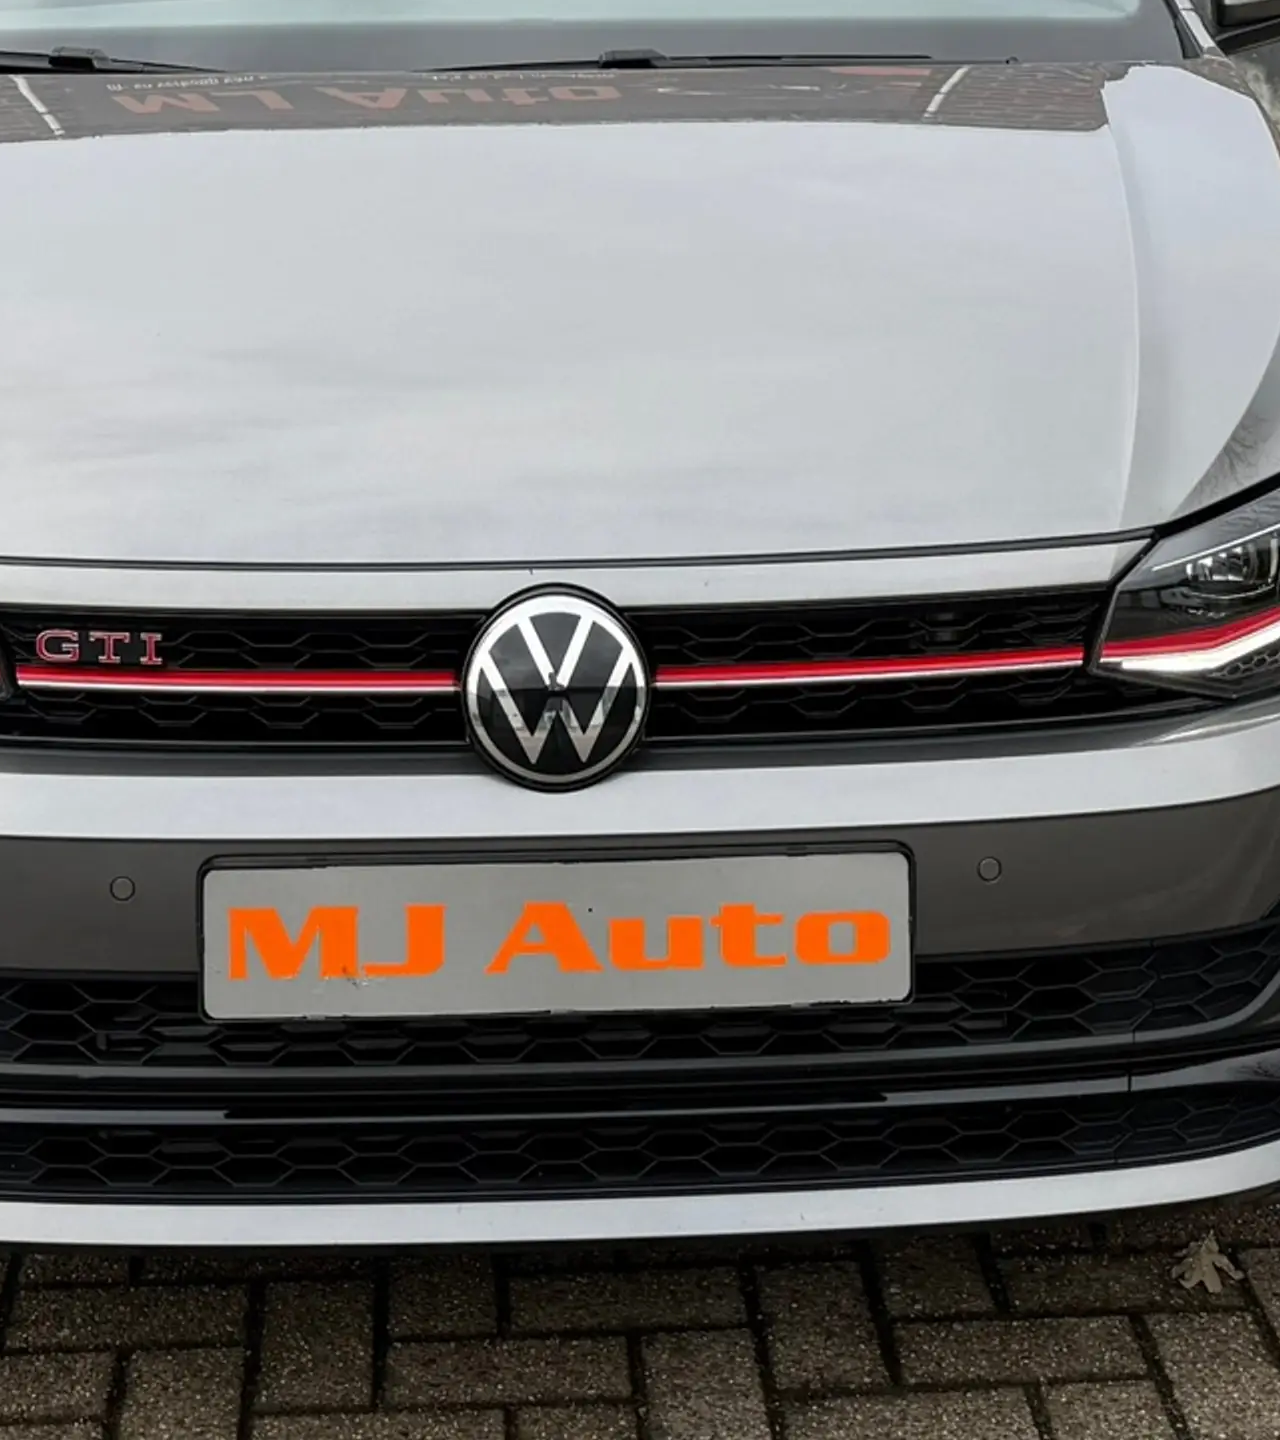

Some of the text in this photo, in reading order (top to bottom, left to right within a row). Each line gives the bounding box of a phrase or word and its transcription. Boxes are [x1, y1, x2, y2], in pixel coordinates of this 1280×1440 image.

[35, 629, 164, 666] GTI
[227, 901, 892, 980] MJ Auto
